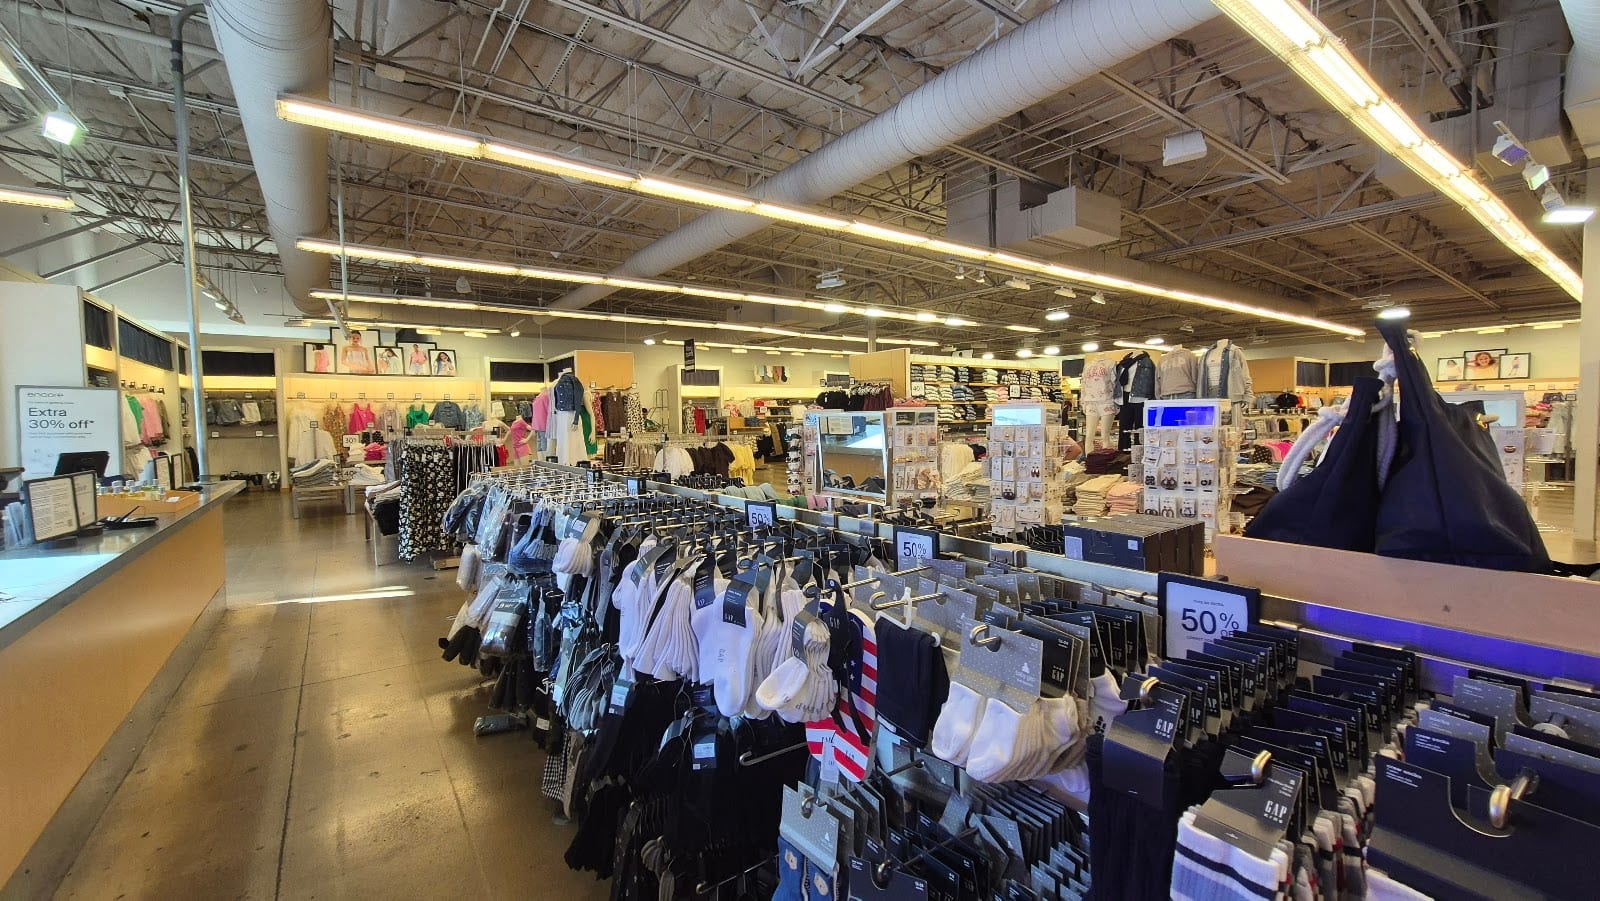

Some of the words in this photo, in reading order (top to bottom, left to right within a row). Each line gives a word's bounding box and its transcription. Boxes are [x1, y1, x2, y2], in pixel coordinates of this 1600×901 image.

[28, 407, 67, 417] Extra
[28, 419, 65, 429] 30%
[751, 512, 771, 525] 50%
[903, 541, 927, 558] 50%
[1181, 607, 1240, 635] 50%
[1155, 718, 1174, 734] GAP
[1264, 799, 1288, 819] GAP
